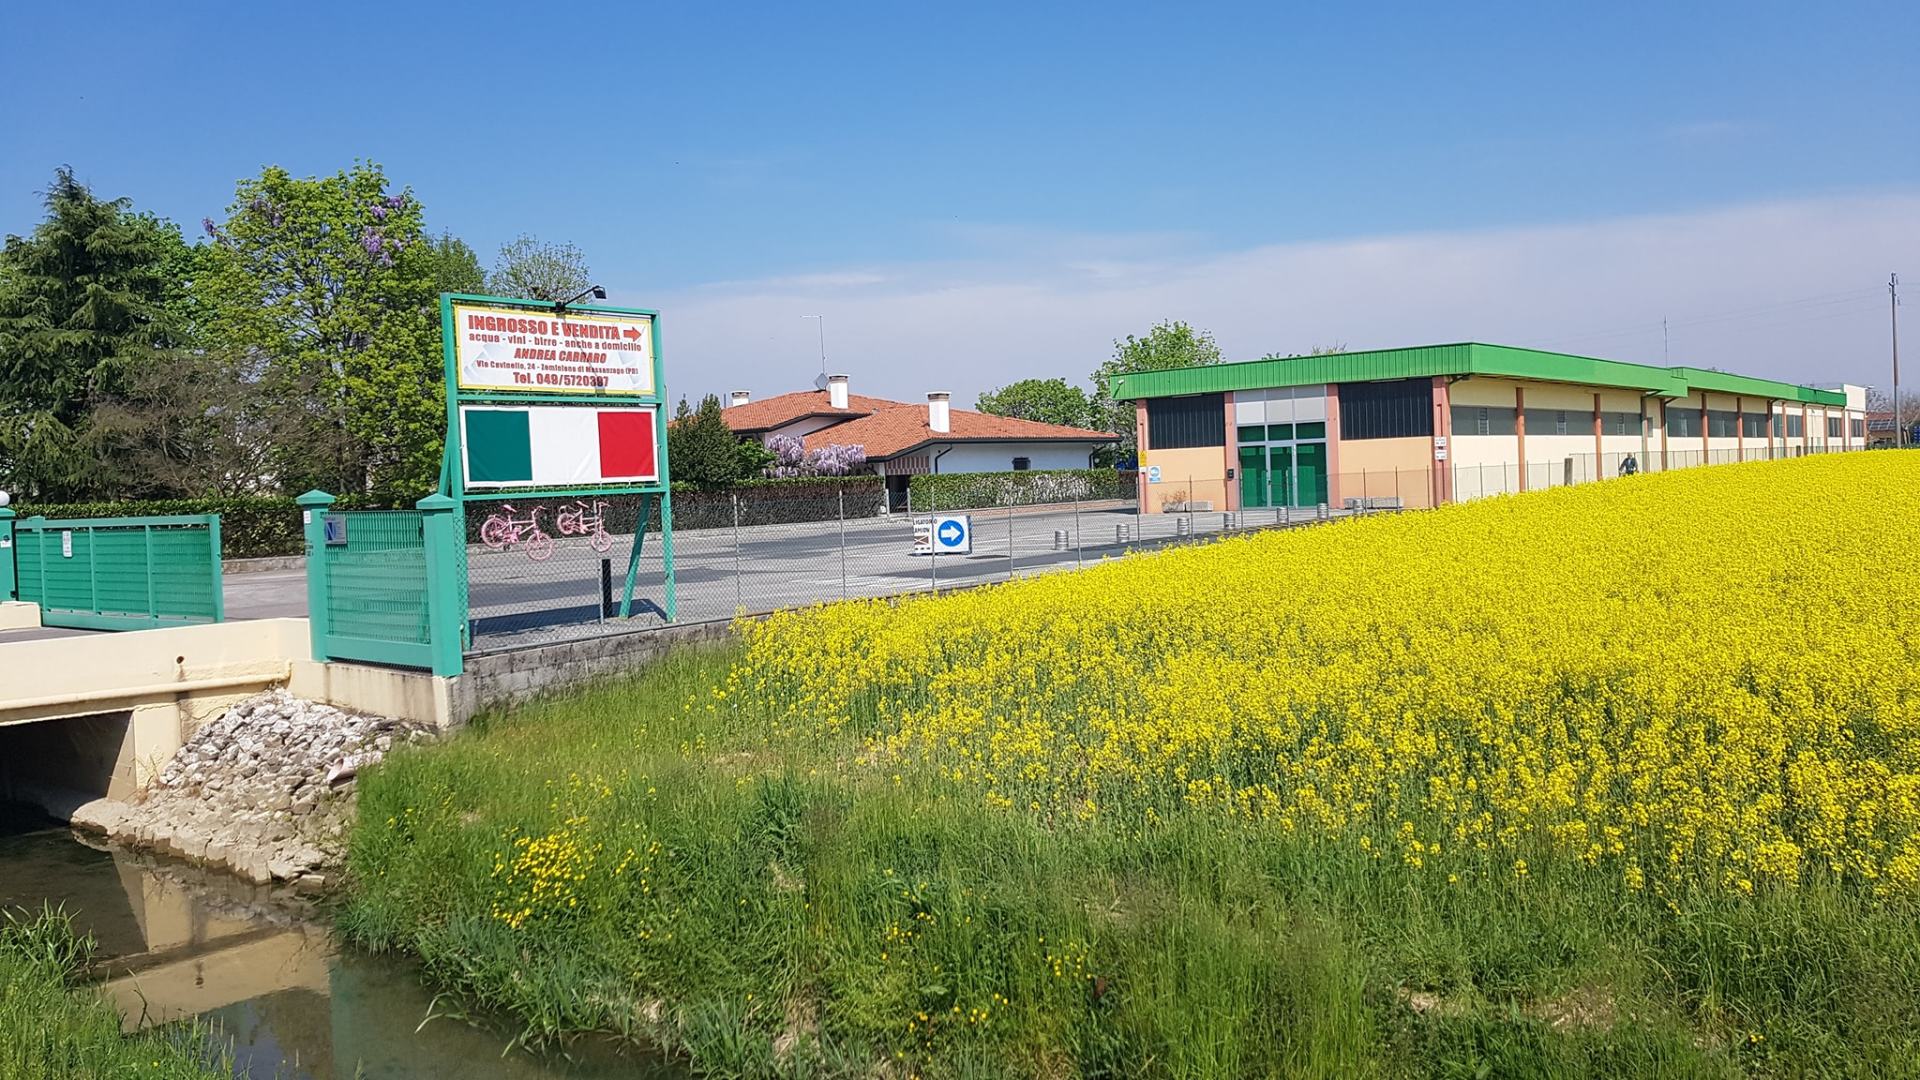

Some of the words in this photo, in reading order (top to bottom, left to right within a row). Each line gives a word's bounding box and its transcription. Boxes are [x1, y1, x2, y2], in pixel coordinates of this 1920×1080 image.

[468, 315, 548, 335] INGROSSO
[551, 322, 559, 336] E
[561, 323, 620, 340] VENDITA
[469, 333, 500, 343] acqua
[508, 335, 526, 344] vini
[534, 337, 557, 347] birre
[565, 340, 592, 349] anche
[602, 341, 641, 351] domicilio
[514, 348, 556, 361] ANDREA
[559, 350, 607, 363] CARRARO
[476, 360, 489, 368] Via
[513, 372, 534, 384] Tel.
